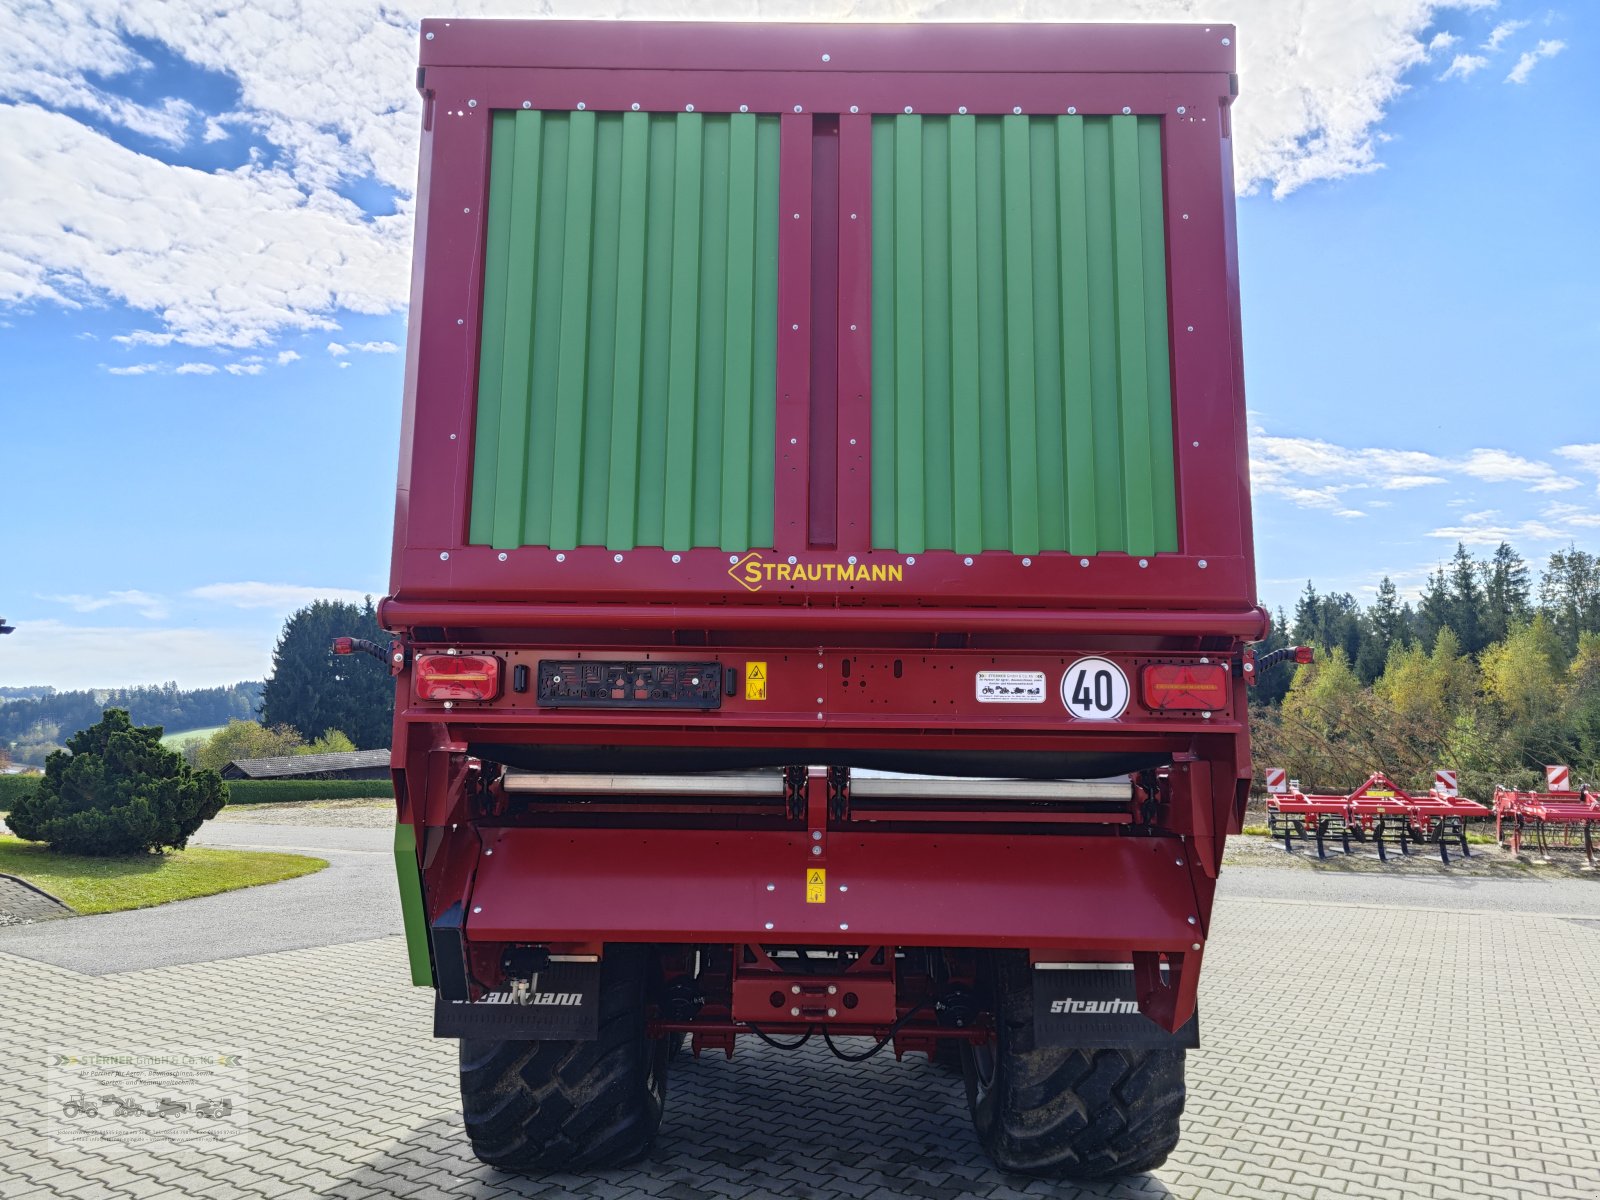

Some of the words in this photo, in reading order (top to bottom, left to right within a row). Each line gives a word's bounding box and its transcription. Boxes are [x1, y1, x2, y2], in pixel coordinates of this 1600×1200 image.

[744, 561, 903, 583] STRAUTMANN
[1072, 669, 1113, 711] 40
[1050, 997, 1141, 1014] strautm
